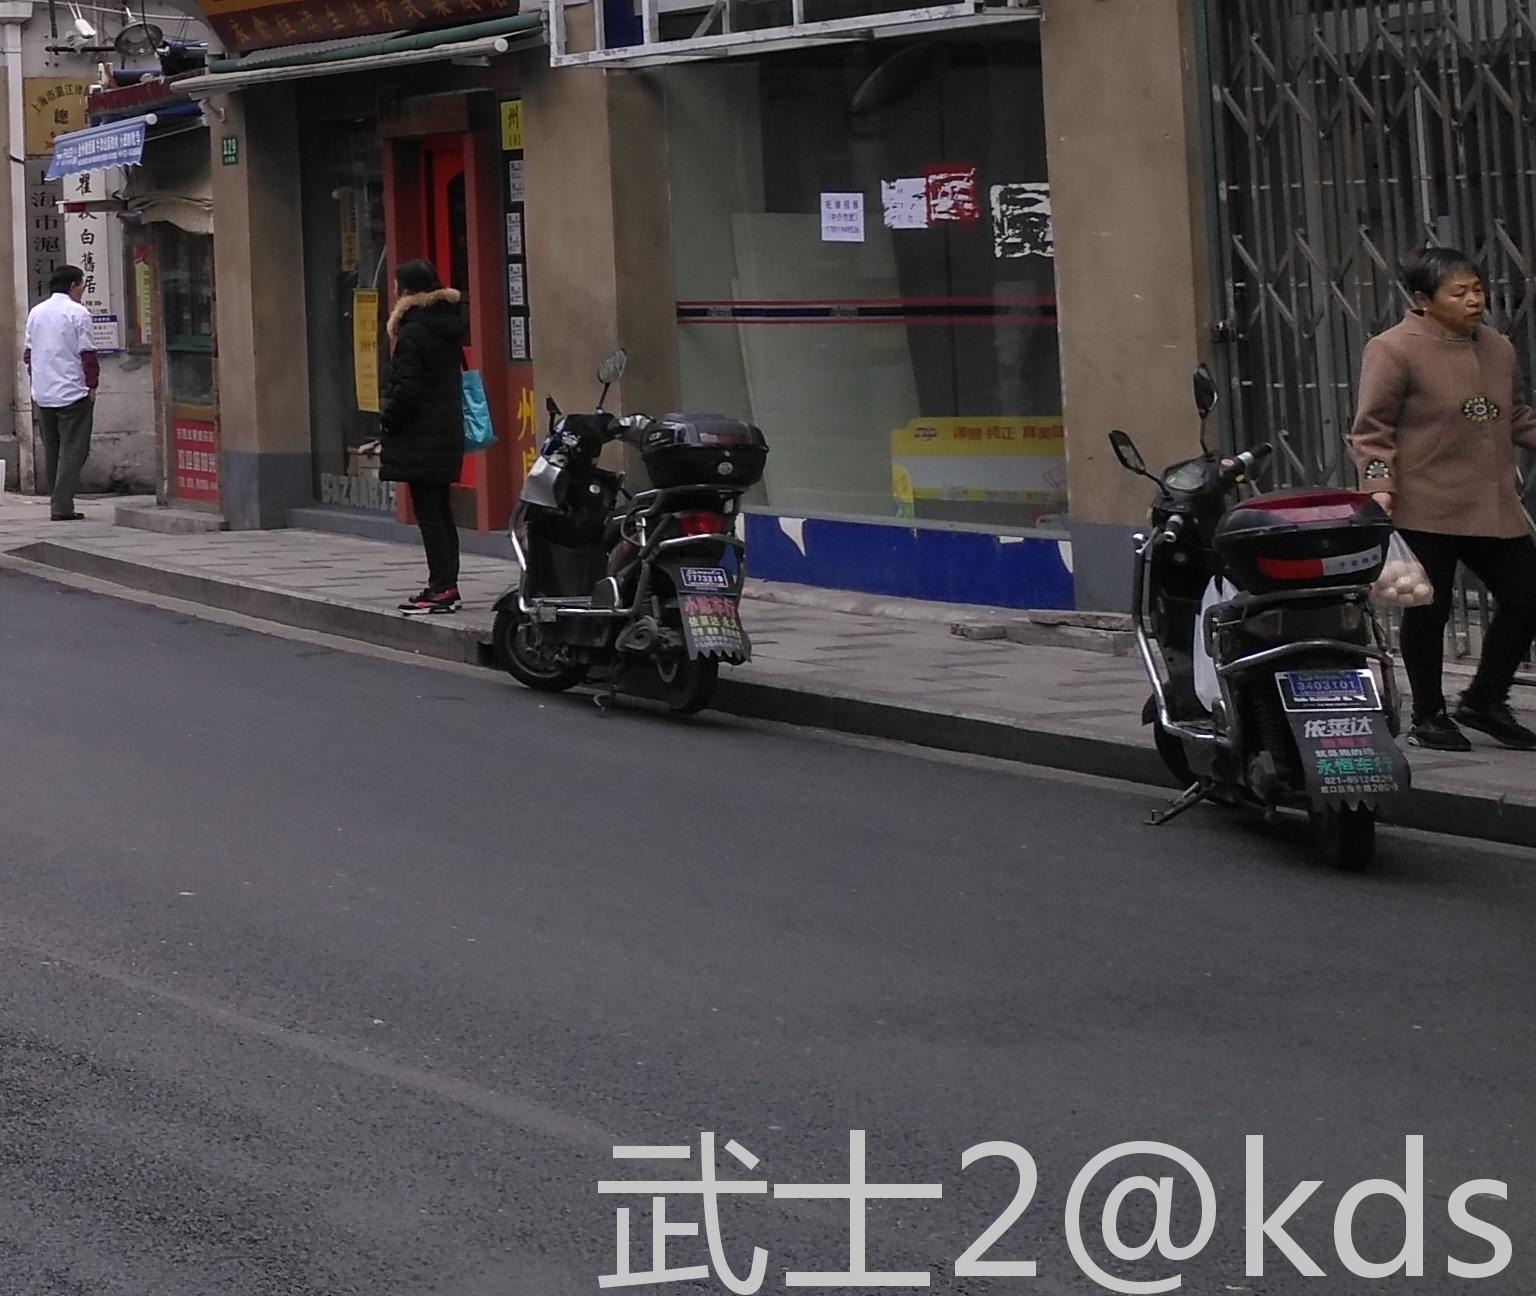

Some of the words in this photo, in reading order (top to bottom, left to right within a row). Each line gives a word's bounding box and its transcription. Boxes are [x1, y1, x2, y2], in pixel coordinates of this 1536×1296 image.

[223, 138, 236, 154] 129
[1297, 680, 1356, 691] 3403101
[1316, 756, 1393, 776] 永恒车行
